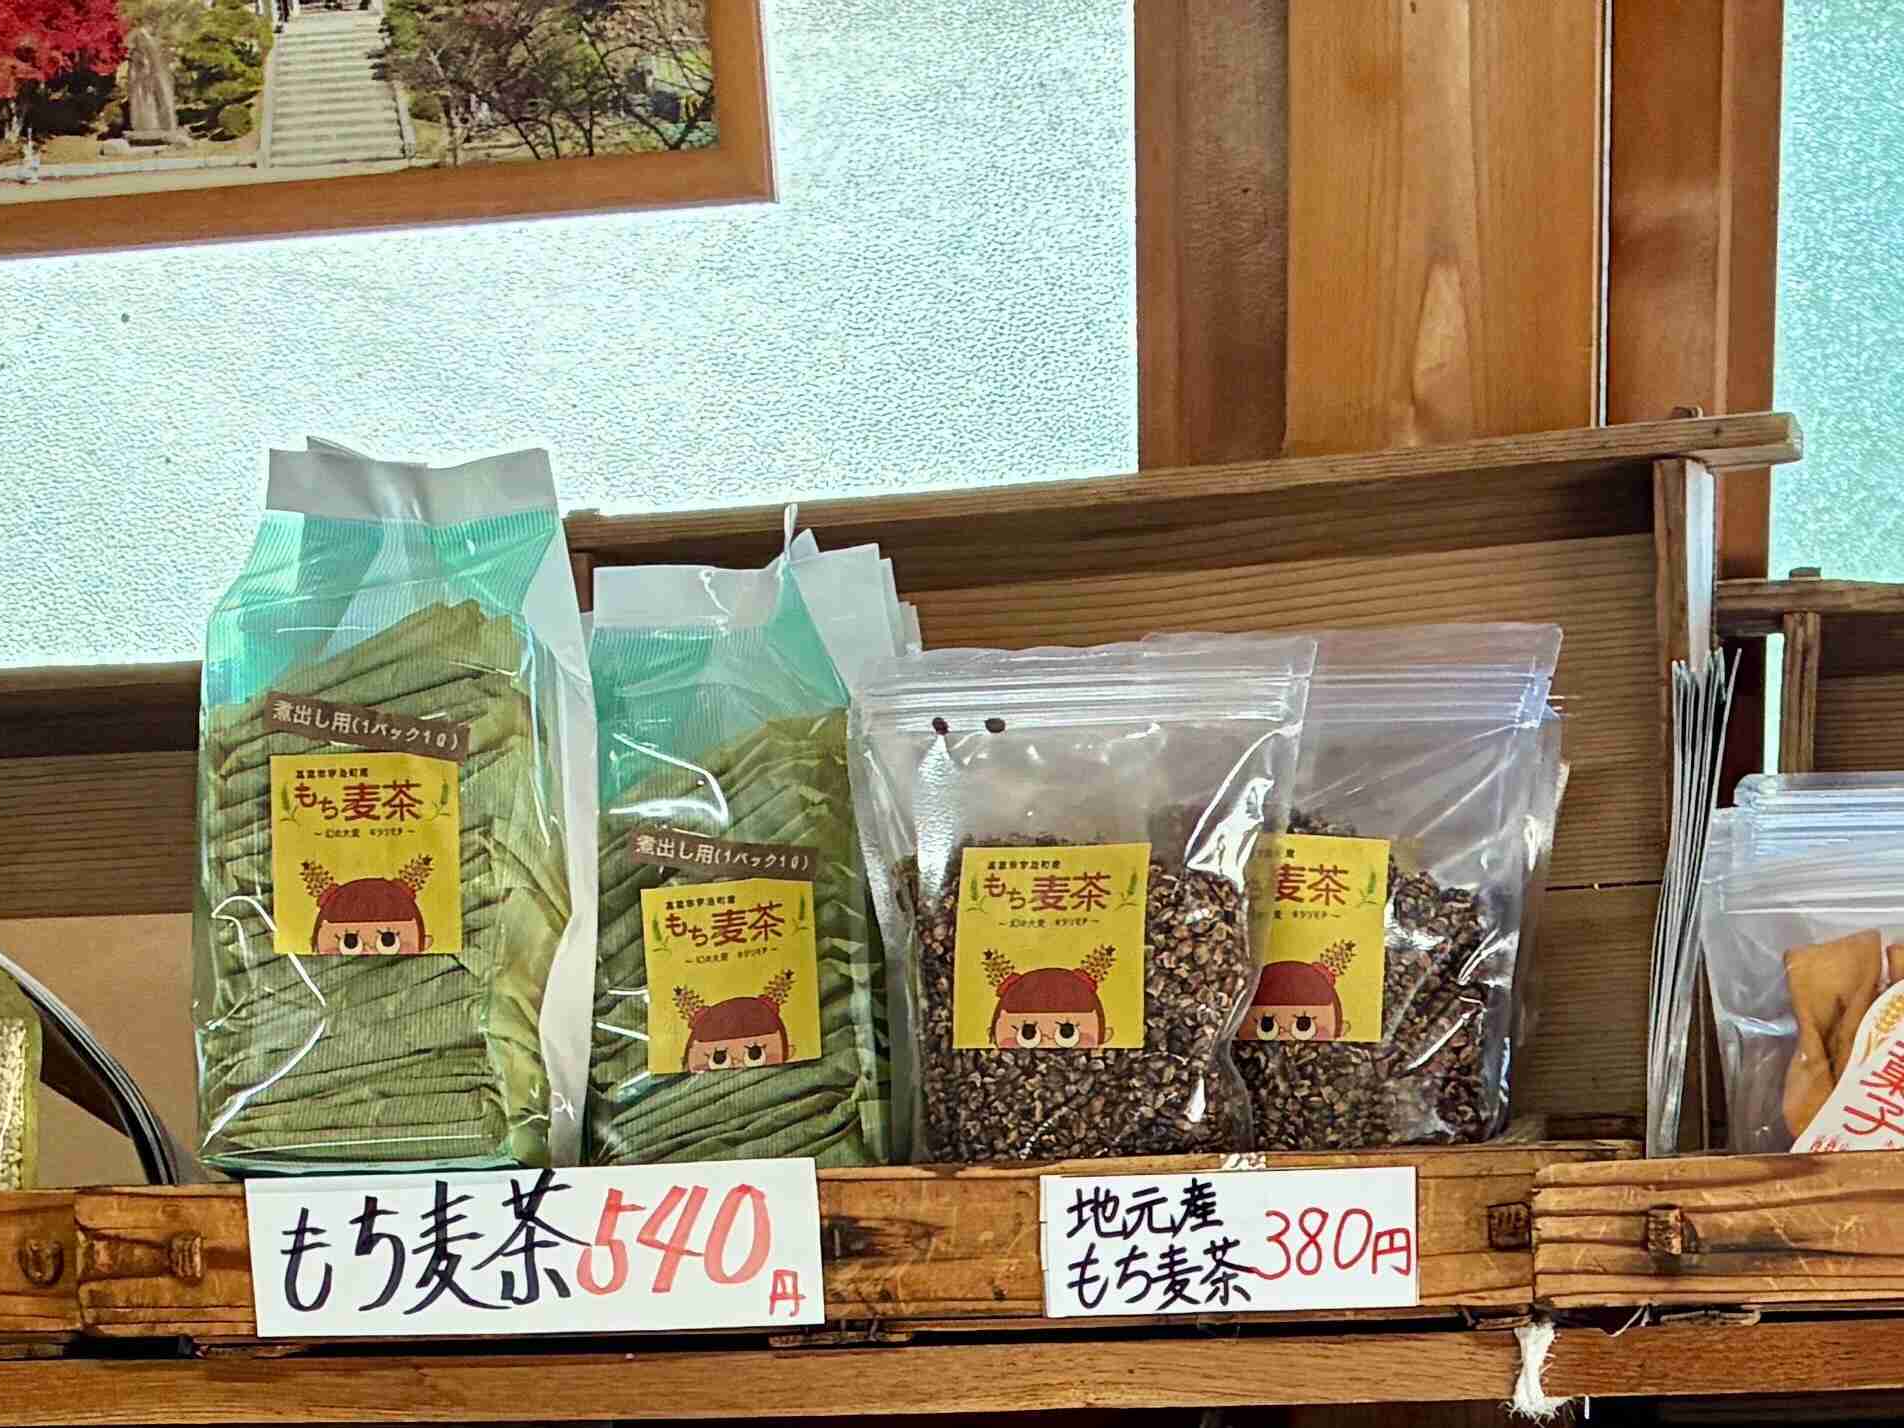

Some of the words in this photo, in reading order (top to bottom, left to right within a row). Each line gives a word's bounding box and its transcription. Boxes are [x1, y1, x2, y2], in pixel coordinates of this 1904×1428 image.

[293, 779, 425, 822] もち麦茶
[983, 871, 1111, 913] もち麦茶
[665, 900, 785, 947] もち麦茶
[1065, 1178, 1224, 1240] 地元産
[280, 1168, 593, 1316] もち麦茶
[577, 1184, 805, 1317] 540円
[1067, 1236, 1254, 1310] もち麦茶
[1251, 1208, 1413, 1279] 380円
